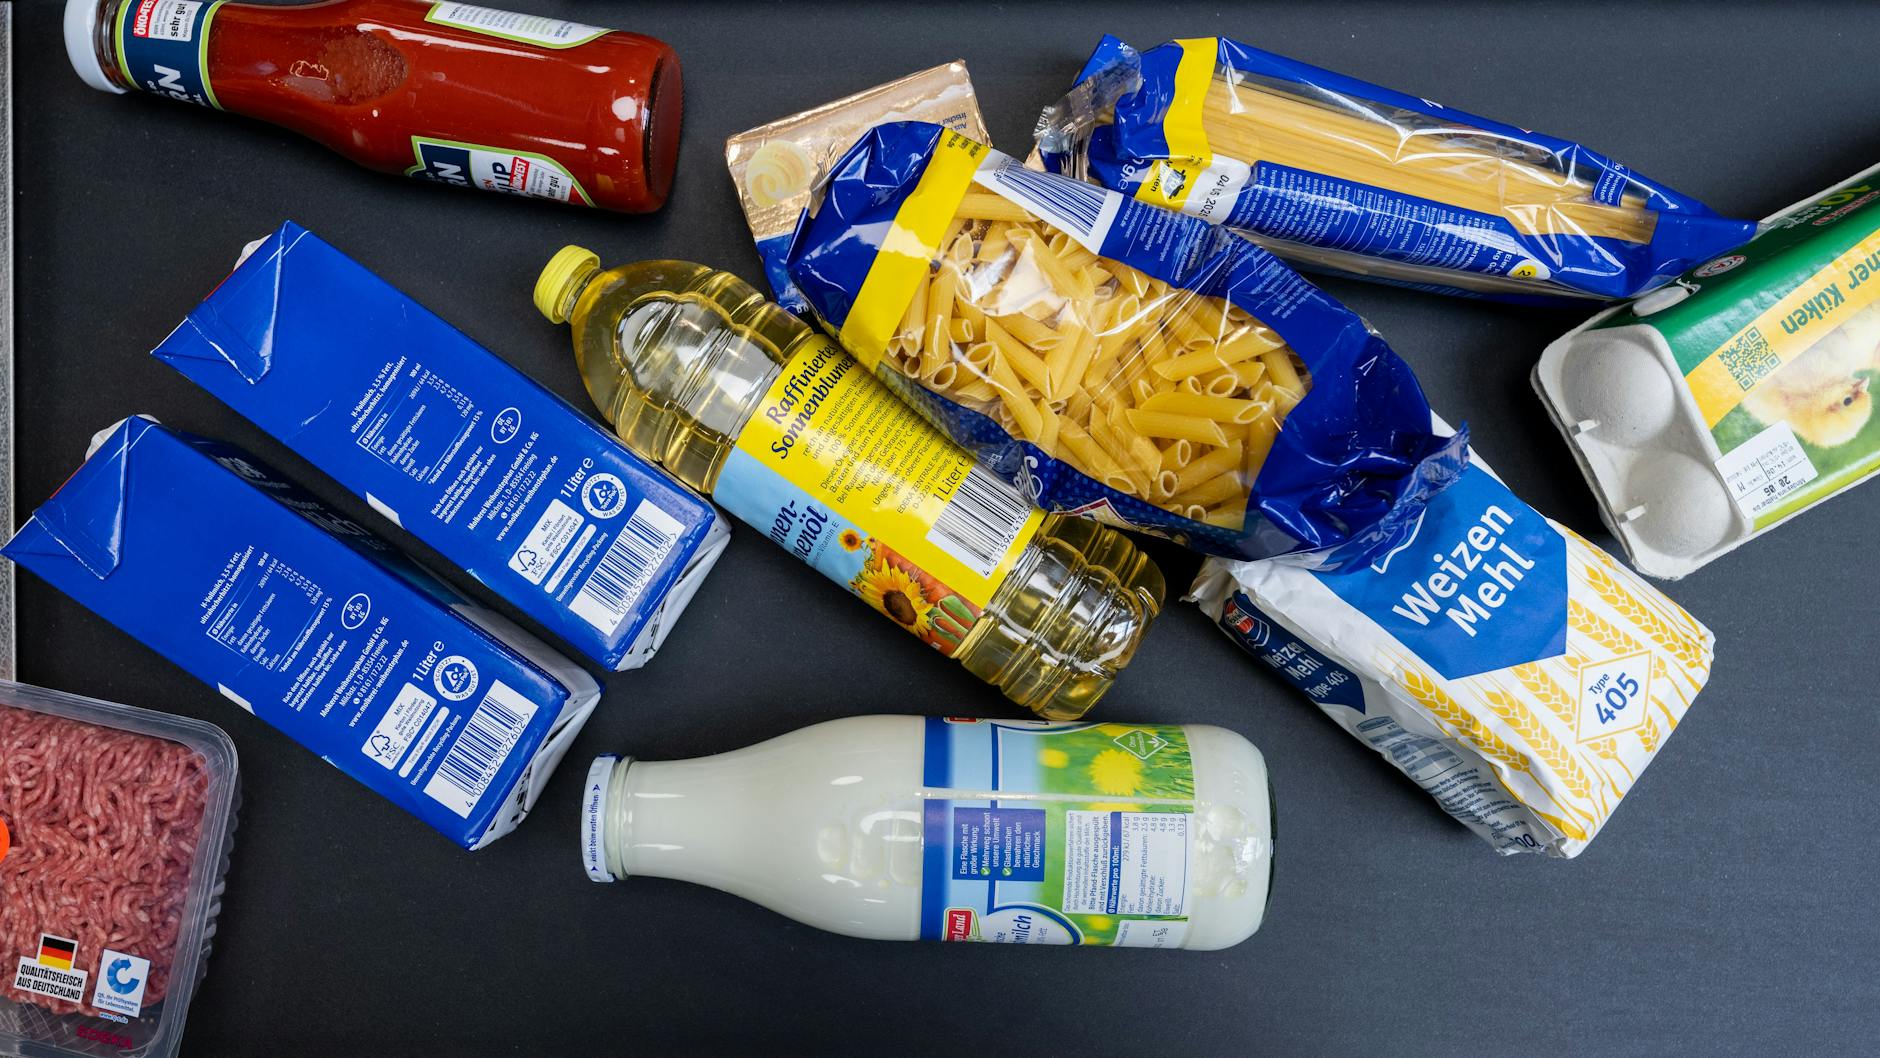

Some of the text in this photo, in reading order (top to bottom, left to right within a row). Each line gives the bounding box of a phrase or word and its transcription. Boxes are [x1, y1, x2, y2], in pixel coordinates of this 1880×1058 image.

[170, 16, 181, 36] sehr
[1216, 174, 1230, 187] 04
[1780, 283, 1846, 334] Küken
[379, 355, 408, 393] homogenisiert
[766, 347, 838, 424] Raffiniertes
[350, 388, 376, 418] H-Vollmilch,
[894, 438, 907, 452] 175
[519, 453, 538, 474] Freising
[829, 467, 850, 493] Braten
[858, 435, 872, 452] zum
[911, 461, 936, 492] ZENTRALE
[467, 506, 488, 531] Molkerei
[483, 469, 515, 509] Weihenstephan
[510, 452, 526, 470] GmbH
[524, 440, 534, 449] Co.
[530, 431, 539, 441] KG
[564, 467, 586, 492] Liter
[820, 466, 839, 490] Dieses
[937, 466, 962, 495] Liter
[496, 455, 558, 542] www.molkerei-weihenstephan.de
[836, 490, 848, 504] Bei
[540, 519, 552, 532] MIX
[560, 518, 579, 543] C014047
[530, 557, 547, 576] FSC
[617, 578, 646, 614] 008452
[643, 540, 672, 577] 027602
[1392, 504, 1514, 626] Weizen
[1446, 542, 1535, 638] Mehl
[370, 638, 389, 659] Freising
[319, 692, 340, 717] Molkerei
[334, 654, 366, 694] Weihenstephan
[362, 637, 376, 655] GmbH
[379, 616, 390, 626] KG
[416, 650, 438, 676] Liter
[1284, 653, 1323, 680] Mehl
[348, 640, 409, 728] www.molkerei-weihenstephan.de
[1304, 670, 1349, 698] Type 405
[1588, 674, 1610, 694] Type
[1596, 672, 1638, 724] 405
[393, 703, 405, 716] MIX
[413, 701, 432, 727] C014047
[472, 759, 501, 796] 008452
[497, 720, 526, 758] 027602
[982, 836, 991, 866] Mehrweg
[1108, 879, 1118, 907] Nährwerte
[17, 976, 80, 1000] AUS DEUTSCHLAND
[20, 964, 83, 988] QUALITÄTSFLEISCH
